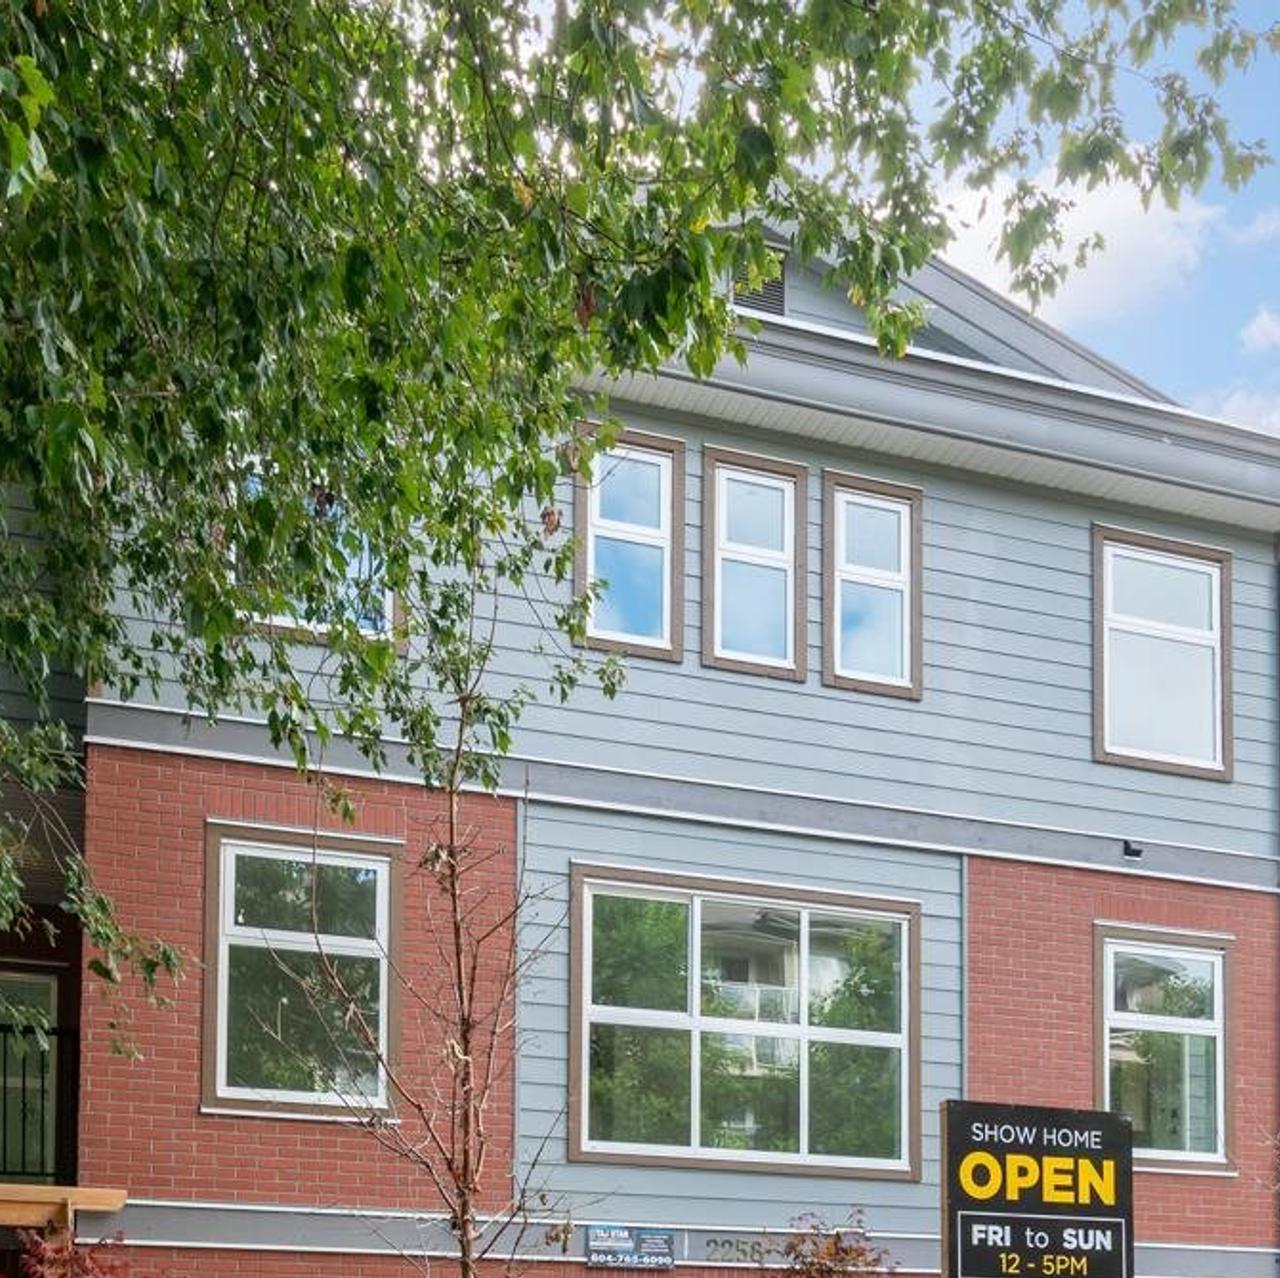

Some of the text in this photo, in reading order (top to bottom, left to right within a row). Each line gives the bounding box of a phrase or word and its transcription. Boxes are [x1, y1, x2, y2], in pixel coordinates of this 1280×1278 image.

[971, 1122, 1103, 1149] SHOW HOME
[959, 1151, 1116, 1206] OPEN
[971, 1224, 1112, 1251] FRI to SUN
[998, 1253, 1020, 1274] 12
[1042, 1255, 1088, 1276] 5PM
